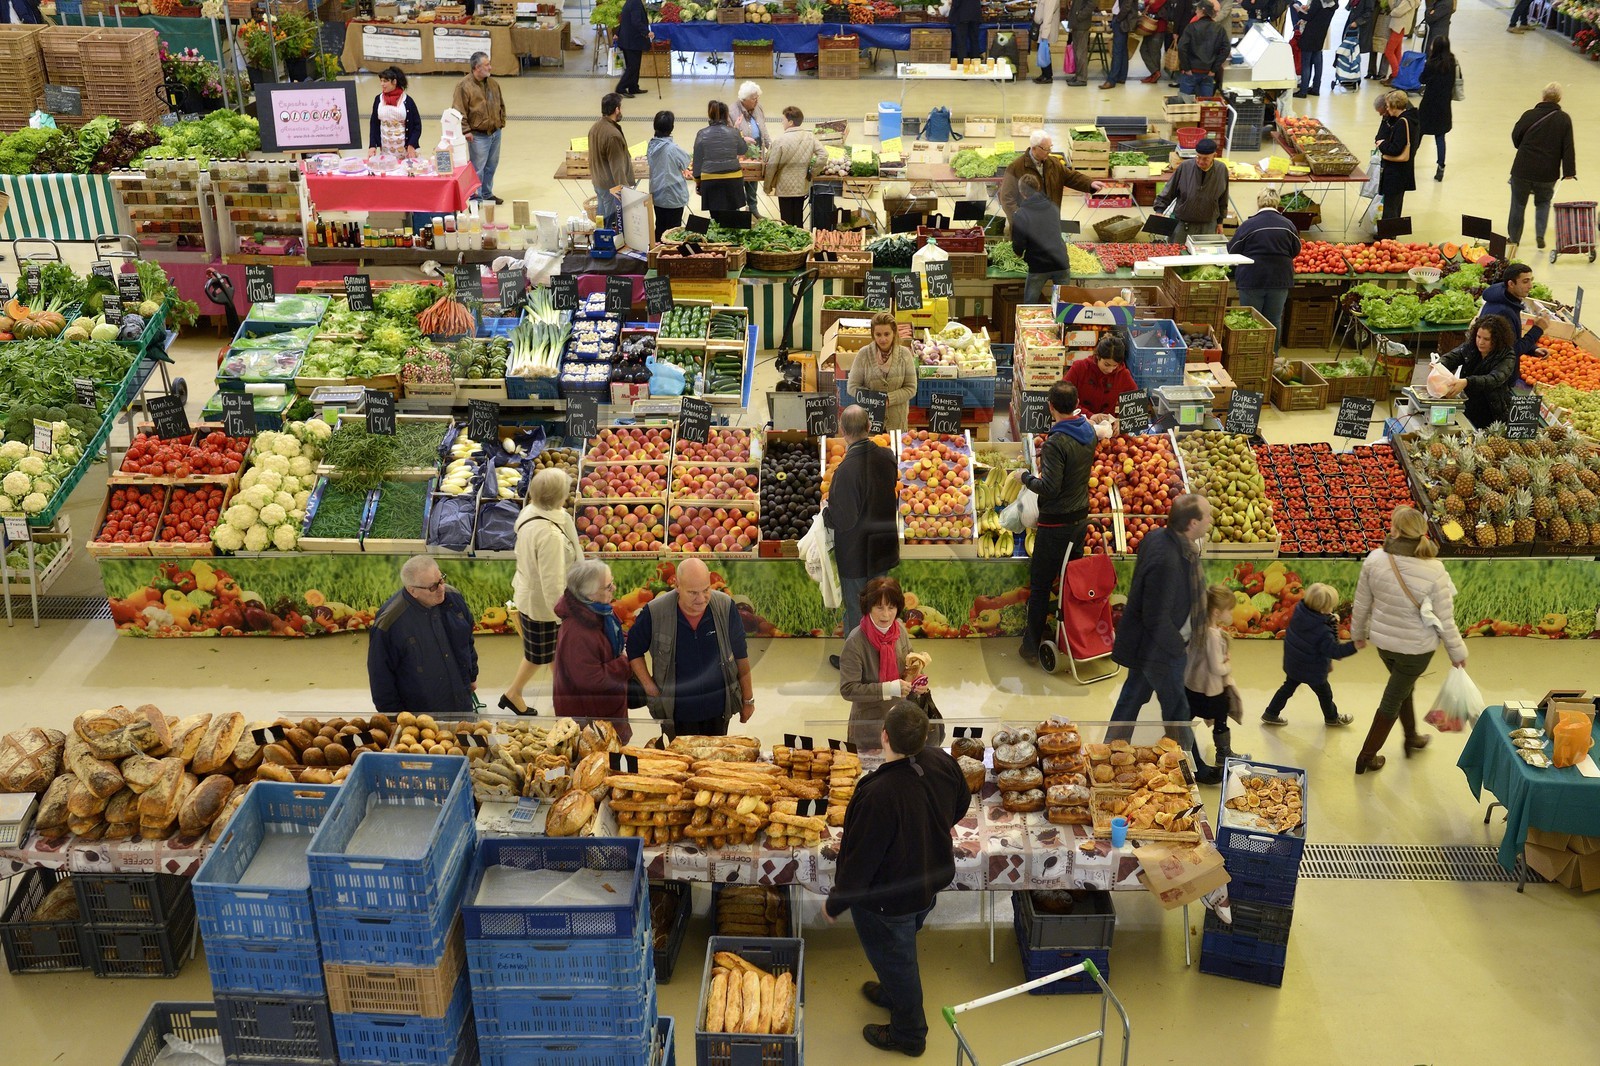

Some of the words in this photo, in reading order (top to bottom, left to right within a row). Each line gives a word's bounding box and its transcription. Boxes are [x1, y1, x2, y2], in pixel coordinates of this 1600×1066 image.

[925, 264, 944, 272] NAVET
[683, 398, 709, 412] POMMES
[806, 399, 836, 407] AVOCATS
[856, 391, 885, 408] ORANGES
[932, 394, 958, 405] POMMES
[1342, 398, 1371, 411] FRAISES
[1454, 547, 1486, 555] Arenal
[721, 855, 752, 863] COFFEE
[1066, 850, 1074, 874] COFFEE
[809, 855, 818, 882] COFFEE
